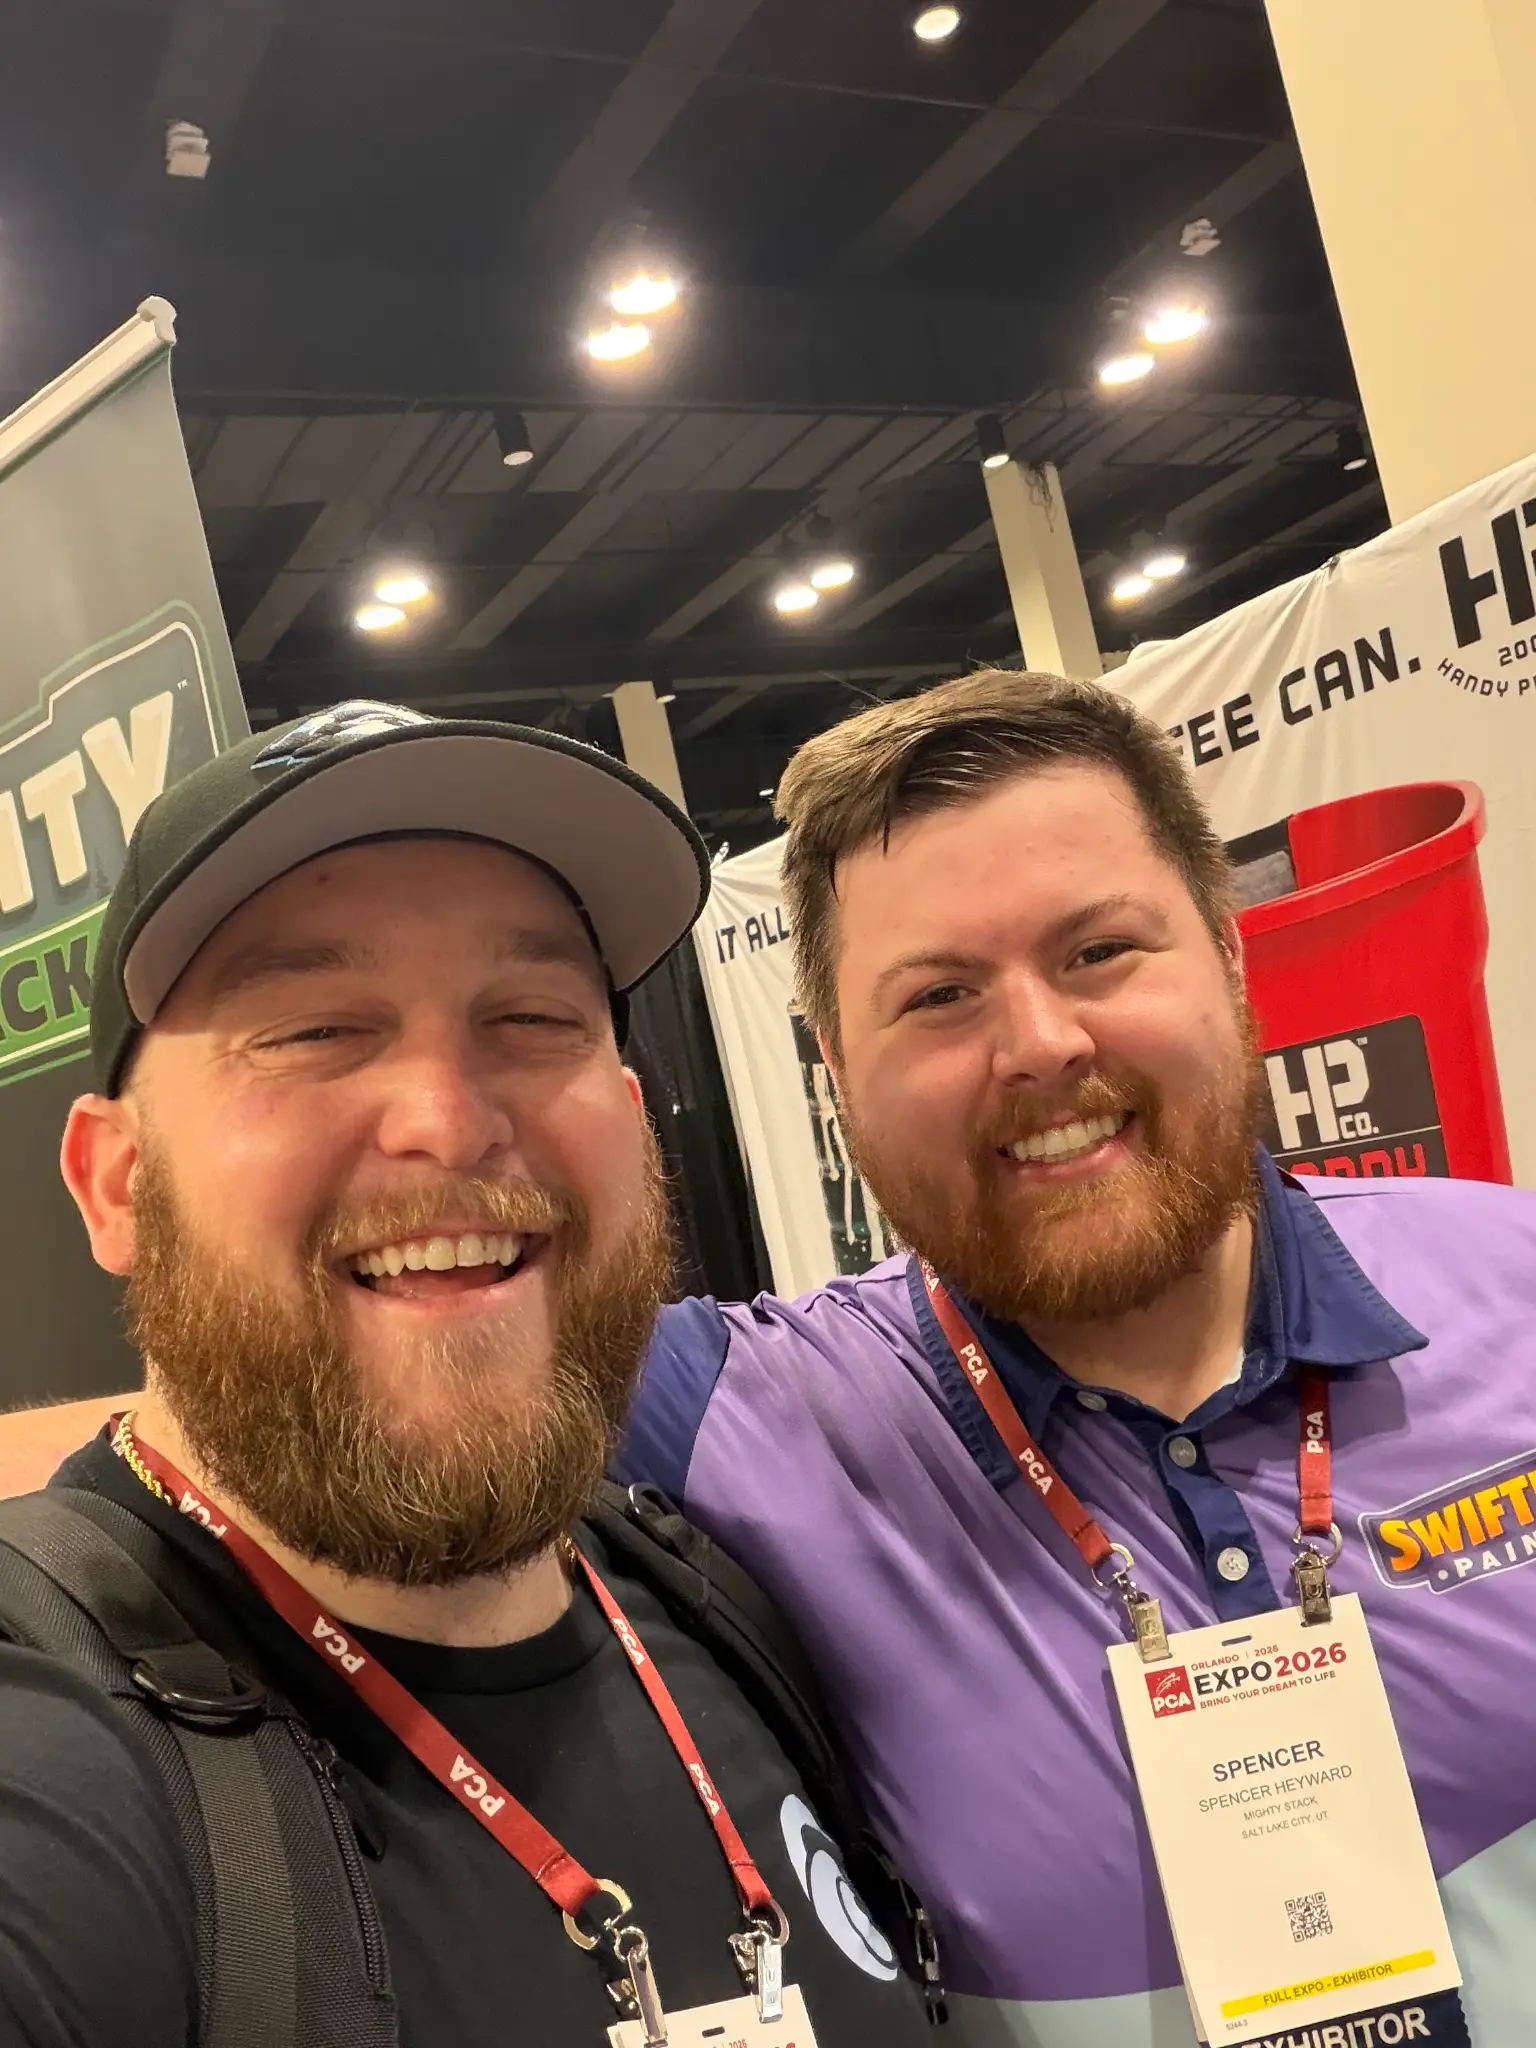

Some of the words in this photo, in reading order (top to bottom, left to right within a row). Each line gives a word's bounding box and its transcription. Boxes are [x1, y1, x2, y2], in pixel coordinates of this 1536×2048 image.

[1439, 498, 1536, 648] H
[1279, 626, 1421, 725] CAN.
[1437, 657, 1508, 698] HANDY
[1518, 674, 1536, 697] P
[715, 924, 737, 964] IT
[745, 905, 790, 954] ALL
[0, 934, 90, 1040] CK
[1265, 1037, 1370, 1150] HP
[1338, 1111, 1380, 1139] CO.
[959, 1342, 989, 1385] PCA
[1306, 1410, 1325, 1454] PCA
[1018, 1447, 1055, 1496] PCA
[311, 1614, 366, 1675] PCA
[610, 1617, 646, 1667] PCA
[1191, 1653, 1240, 1671] ORLANDO
[1153, 1691, 1192, 1712] PCA
[1200, 1695, 1231, 1709] BRING
[1232, 1688, 1260, 1702] YOUR
[1262, 1679, 1297, 1695] DREAM
[1298, 1676, 1312, 1686] TO
[1314, 1670, 1337, 1683] LIFE
[1213, 1740, 1325, 1782] SPENCER
[449, 1753, 506, 1818] PCA
[688, 1762, 721, 1818] PCA
[1199, 1784, 1273, 1813] SPENCER
[1275, 1765, 1353, 1795] HEYWARD
[1241, 1826, 1264, 1839] SALT
[1267, 1820, 1290, 1833] LAKE
[1316, 1810, 1329, 1821] UT
[1243, 1804, 1282, 1821] MIGHTY
[1284, 1796, 1318, 1812] STACK
[1263, 1992, 1292, 2006] FULL
[1293, 1980, 1324, 1997] EXPO
[1333, 1963, 1393, 1987] EXHIBITOR
[1241, 2006, 1431, 2048] HIBITOR
